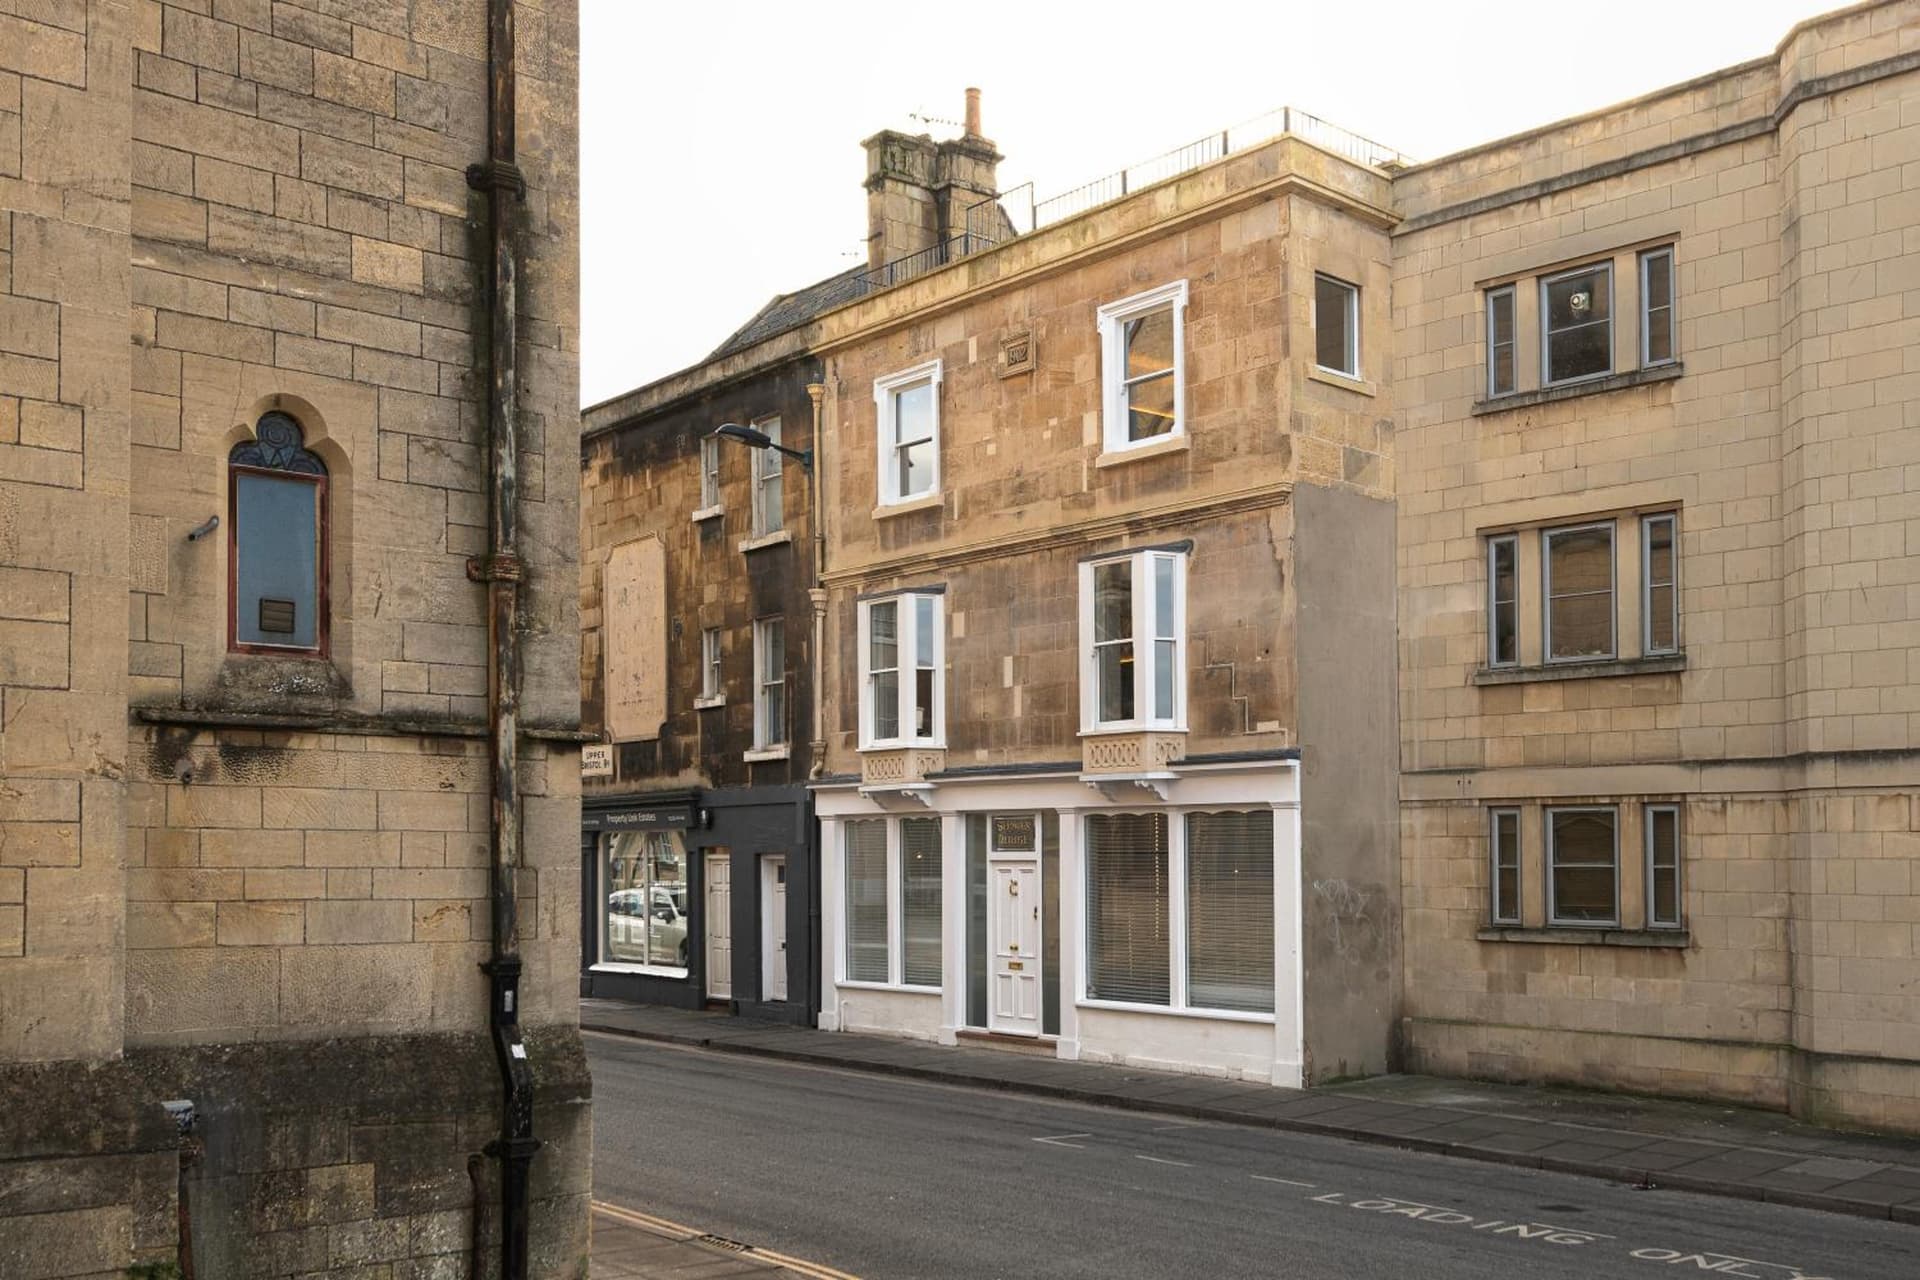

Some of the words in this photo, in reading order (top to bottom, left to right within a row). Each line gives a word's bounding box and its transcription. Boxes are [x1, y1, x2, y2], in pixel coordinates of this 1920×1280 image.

[585, 750, 605, 760] UPPER
[606, 813, 627, 825] Property
[1310, 1192, 1597, 1245] LOADING
